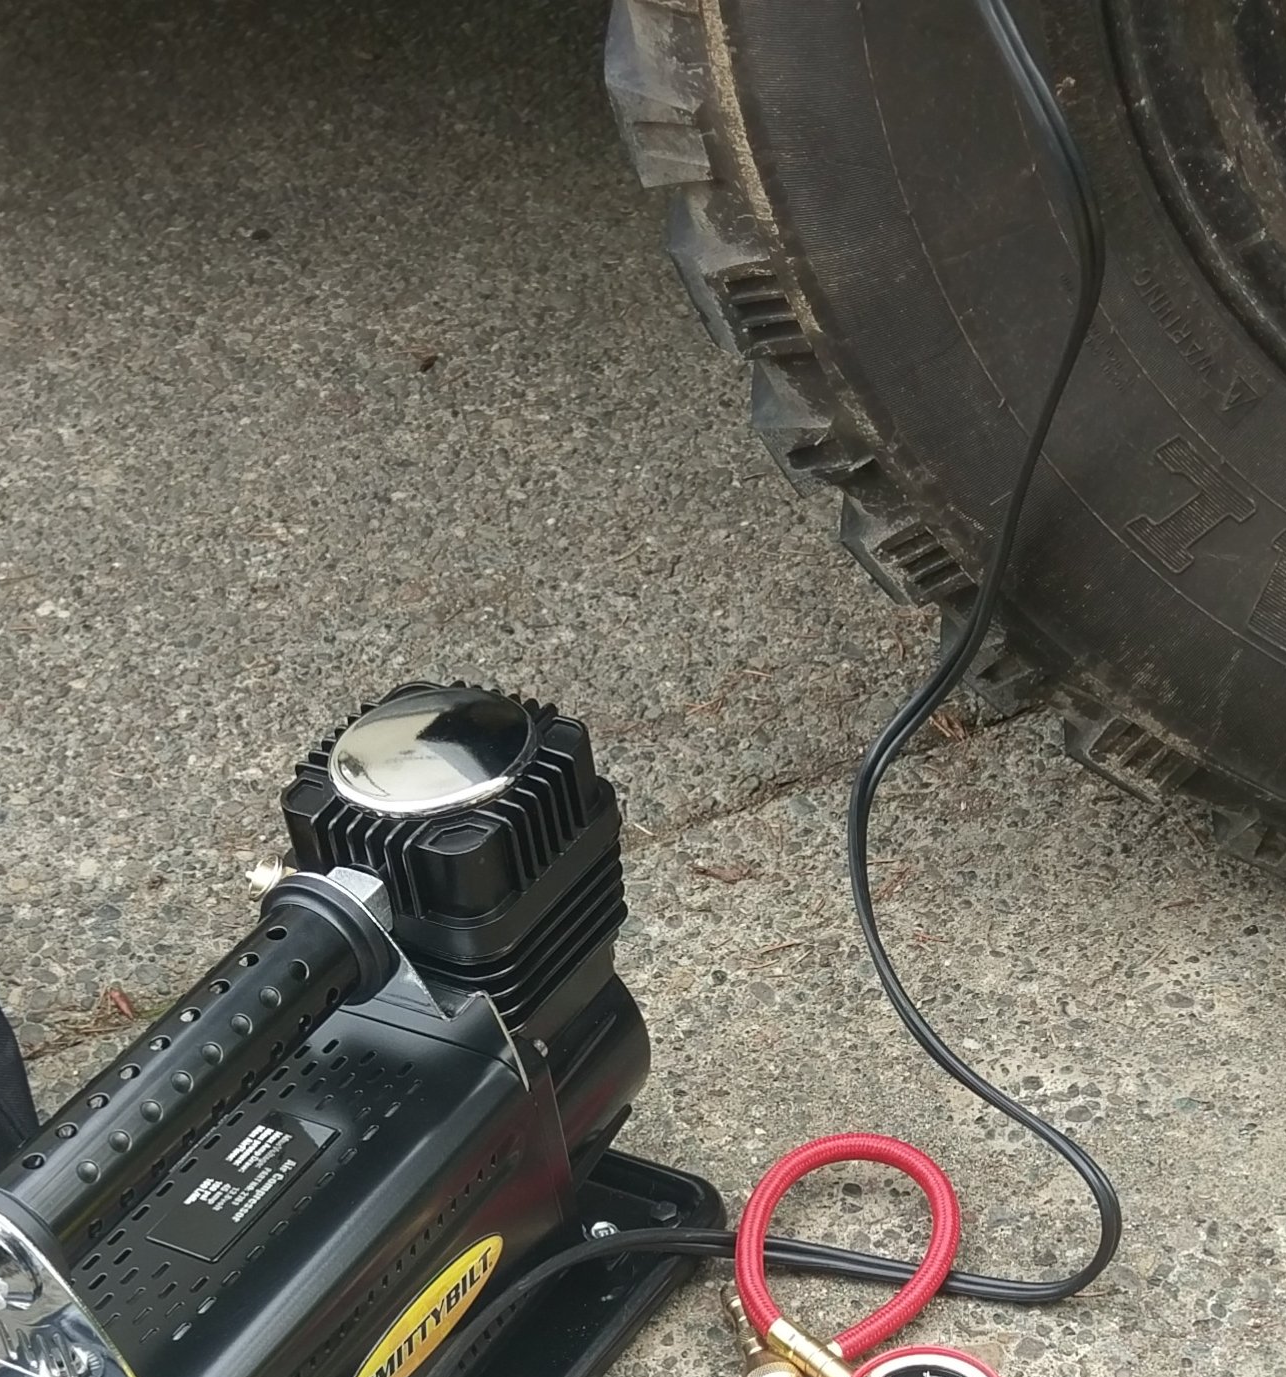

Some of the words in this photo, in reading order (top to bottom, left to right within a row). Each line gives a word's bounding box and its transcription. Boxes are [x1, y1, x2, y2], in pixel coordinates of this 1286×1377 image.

[265, 1130, 283, 1144] Max
[279, 1158, 296, 1172] Air
[231, 1172, 284, 1222] Compressor
